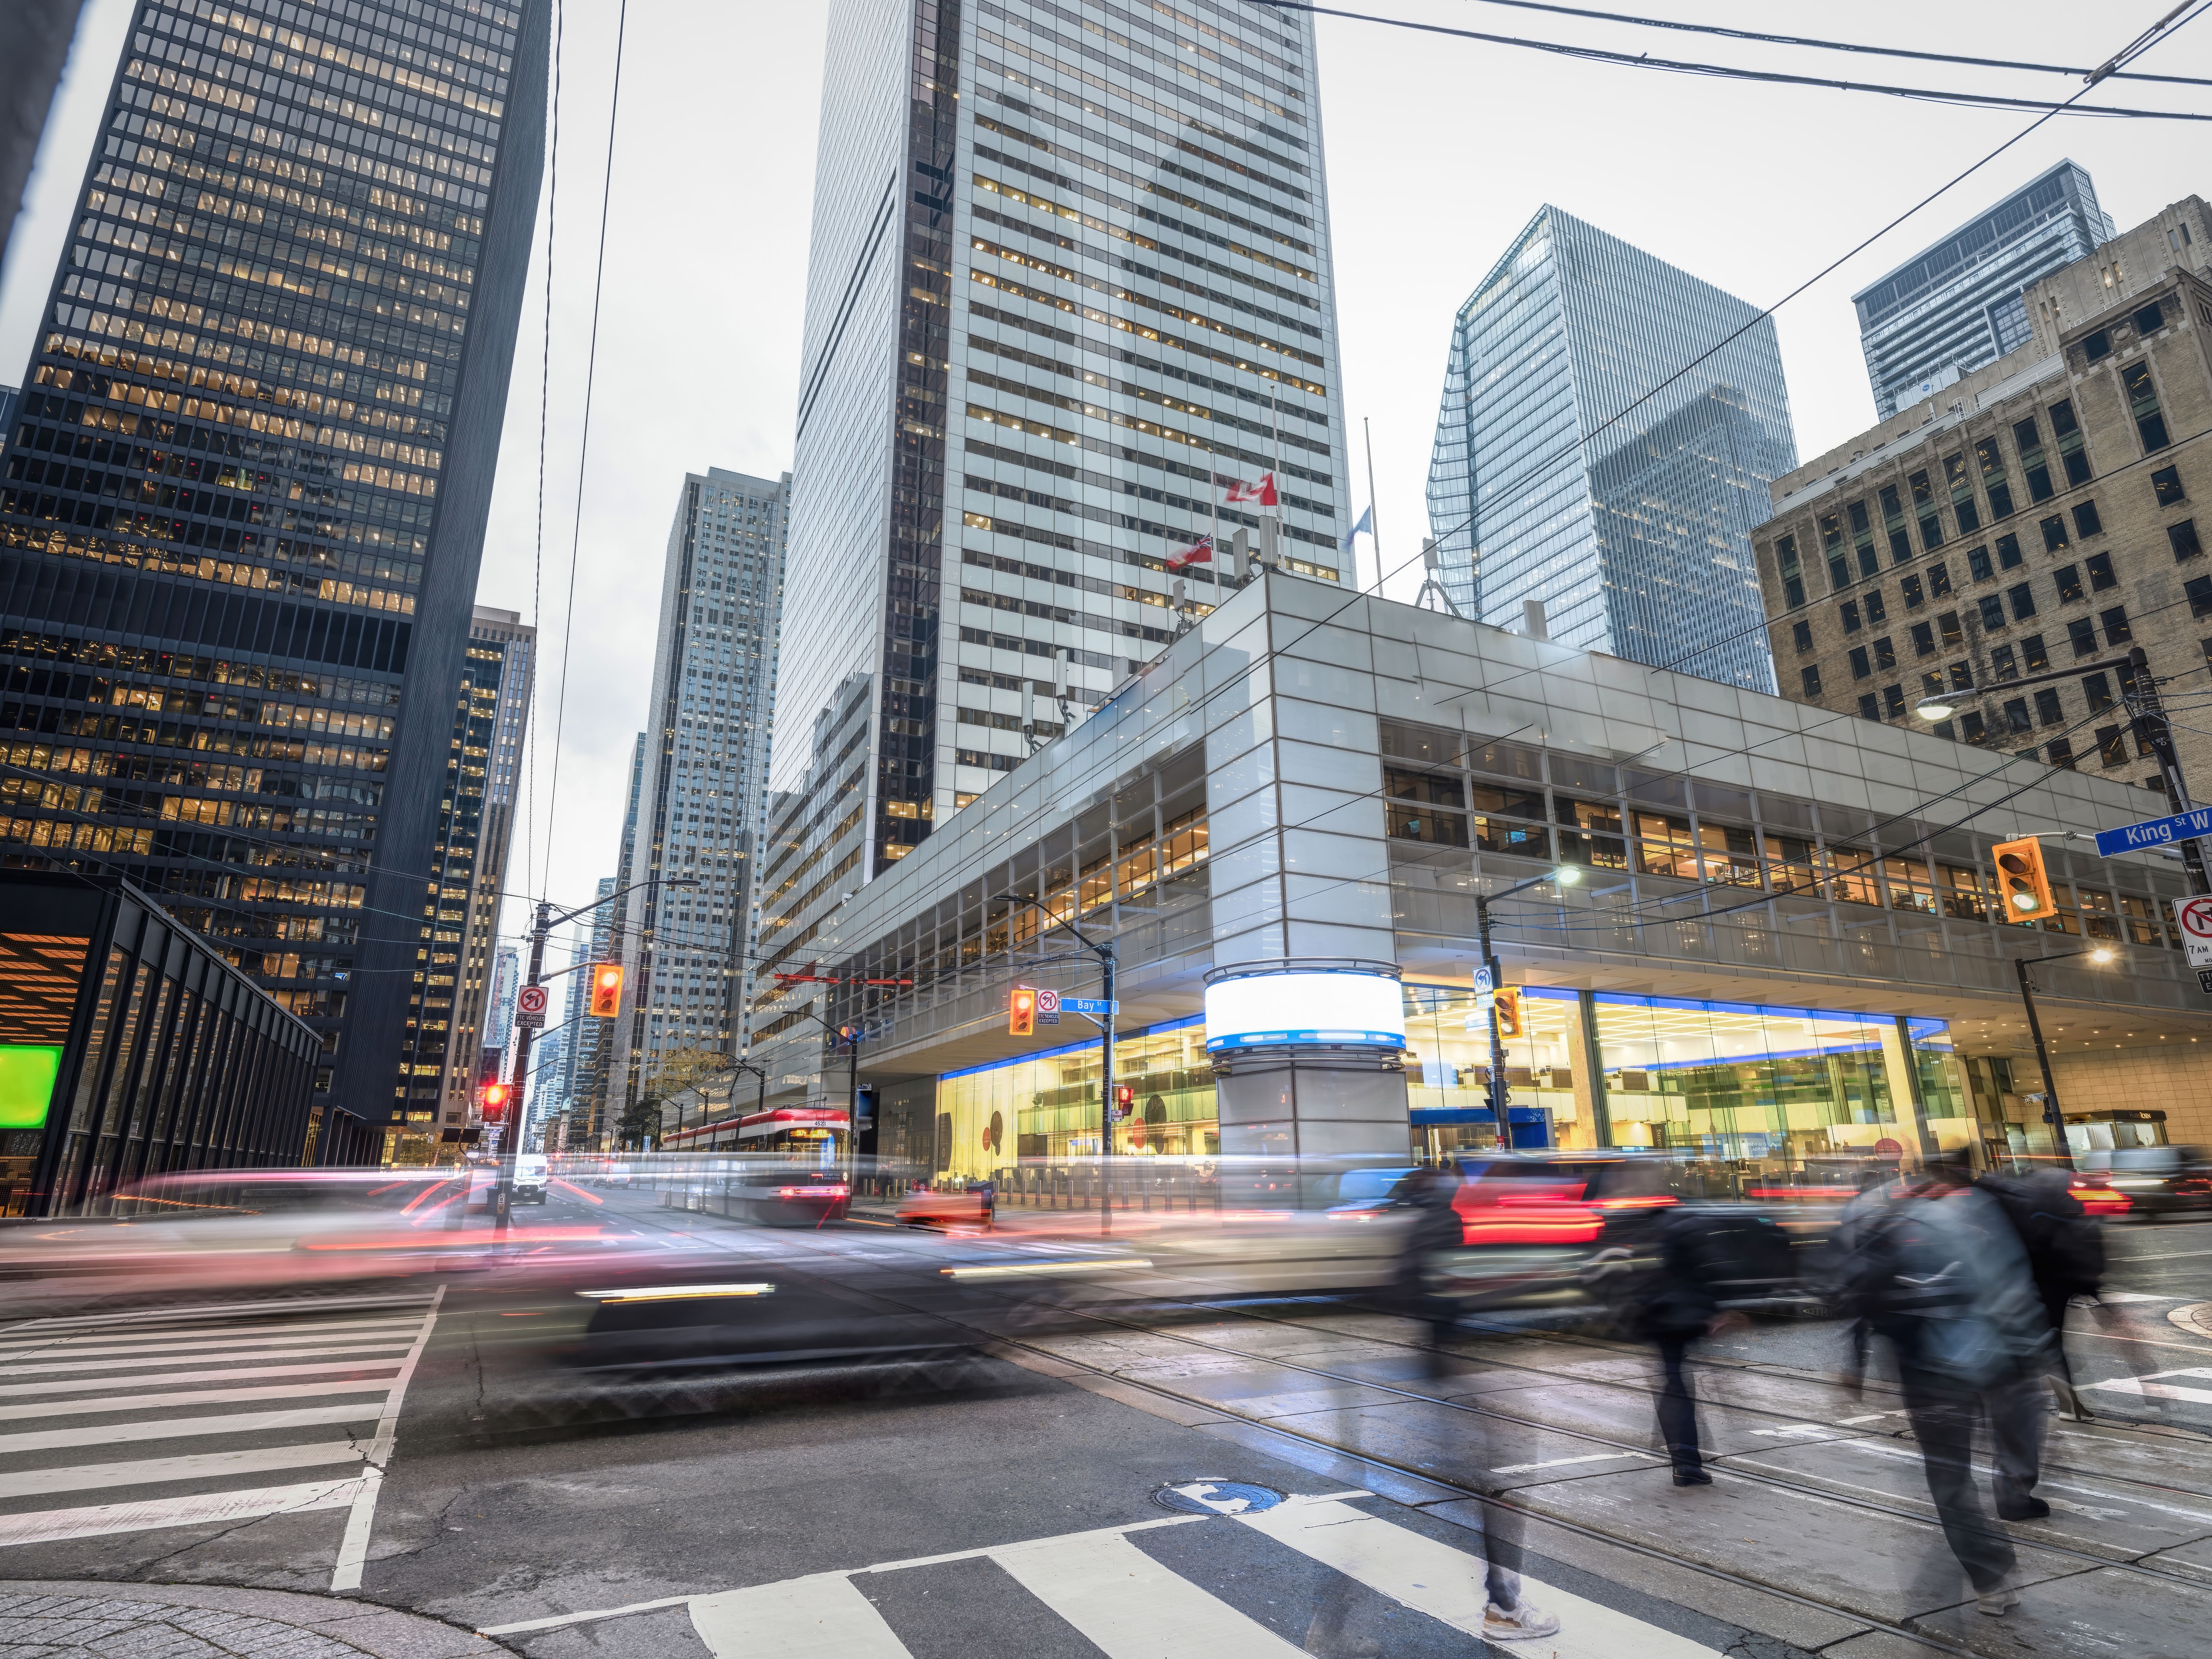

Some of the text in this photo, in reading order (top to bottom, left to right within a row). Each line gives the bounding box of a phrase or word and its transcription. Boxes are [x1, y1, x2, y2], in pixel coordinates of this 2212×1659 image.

[2126, 811, 2209, 844] King St W
[2188, 945, 2209, 954] 7 AM
[1078, 1000, 1094, 1012] Bay
